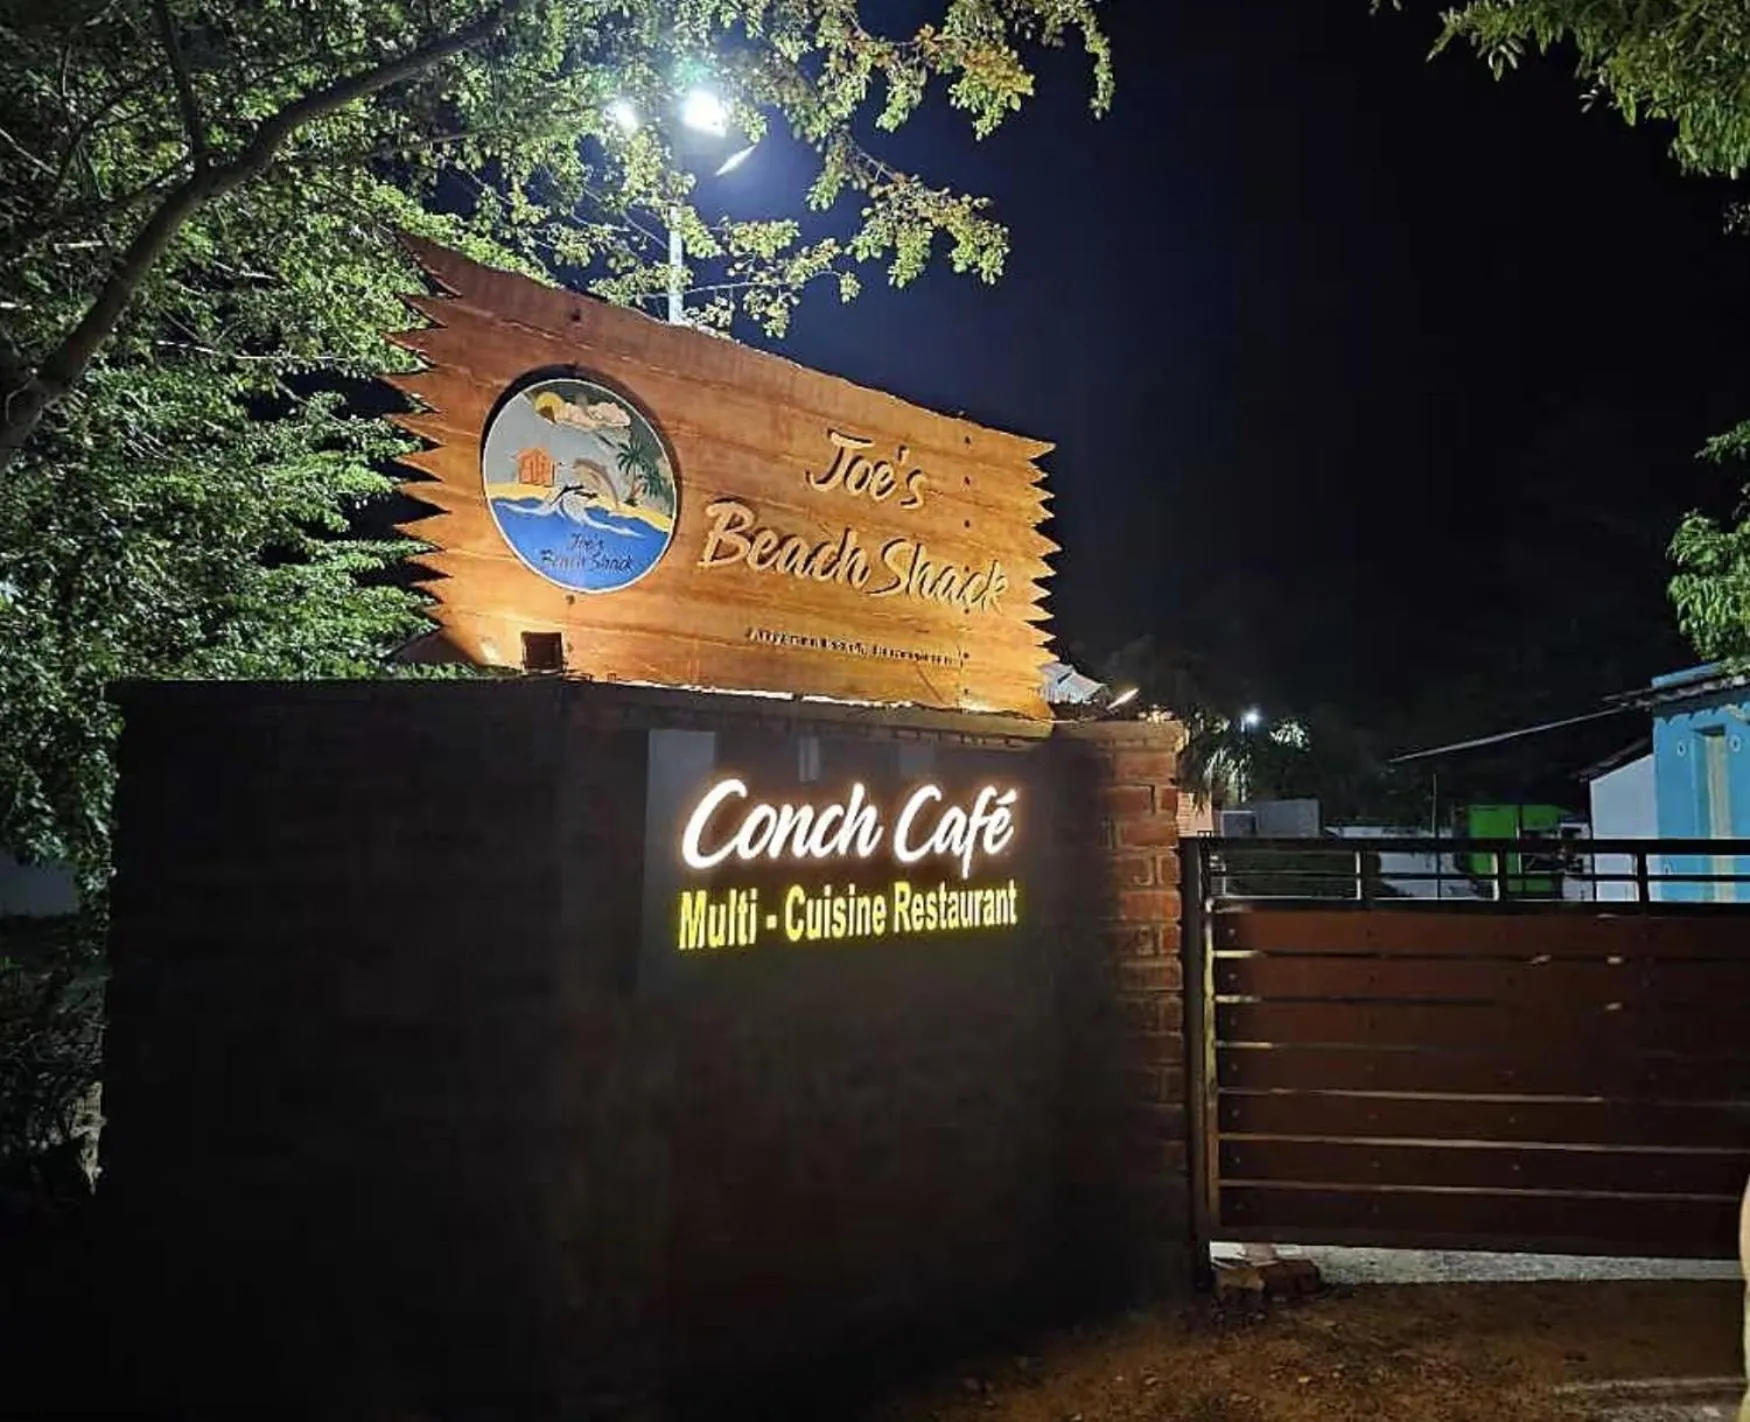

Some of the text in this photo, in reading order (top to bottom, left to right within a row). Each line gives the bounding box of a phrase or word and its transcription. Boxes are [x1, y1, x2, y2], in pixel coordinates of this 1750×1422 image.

[804, 428, 931, 510] Joe's
[697, 497, 1009, 613] Beach Shack
[681, 778, 1020, 879] Conch Café
[679, 888, 758, 950] Multi
[784, 882, 887, 942] Cuisine
[894, 878, 1018, 934] Restaurant
